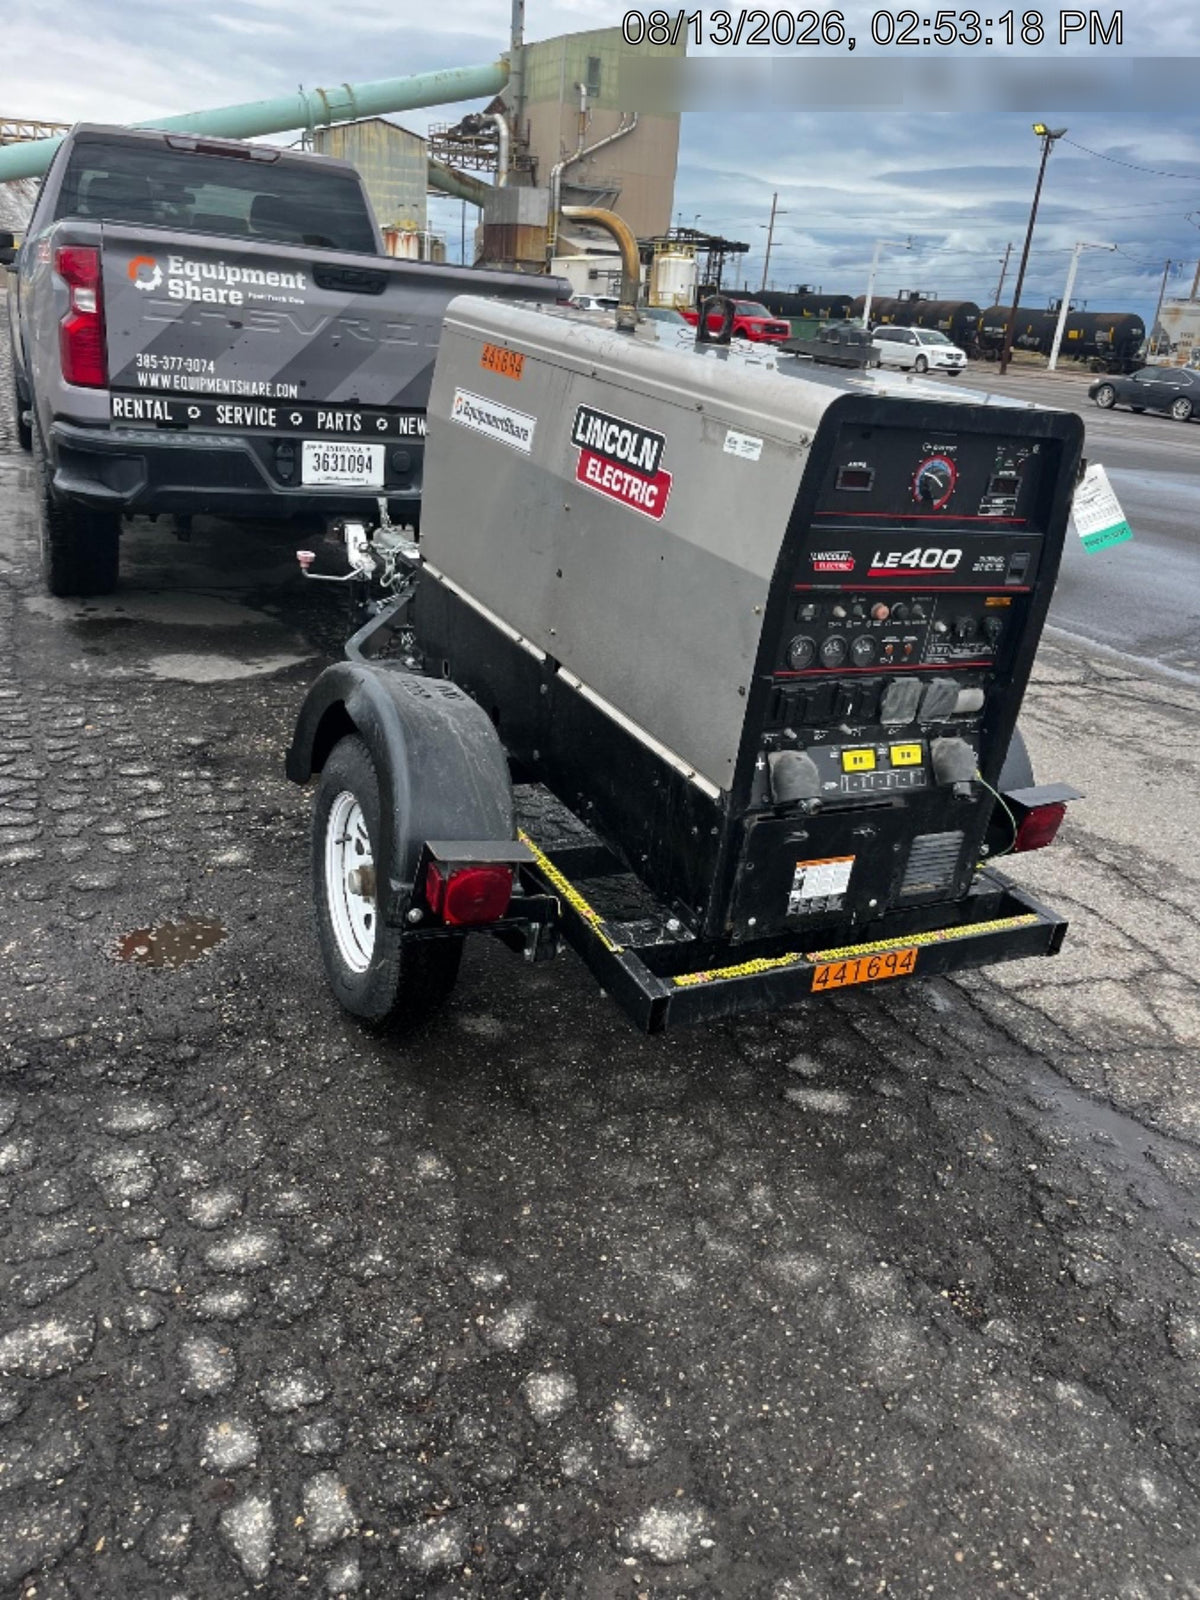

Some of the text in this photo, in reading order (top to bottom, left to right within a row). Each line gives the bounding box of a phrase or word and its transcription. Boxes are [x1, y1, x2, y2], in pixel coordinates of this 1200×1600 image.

[167, 256, 307, 291] Equipment
[168, 279, 244, 305] Share
[136, 353, 216, 374] 385-377-3074
[113, 398, 173, 421] RENTAL
[217, 405, 277, 427] SERVICE
[318, 411, 363, 432] PARTS
[575, 411, 660, 472] LINCOLN
[312, 452, 373, 474] 3631094
[586, 458, 659, 509] ELECTRIC
[870, 547, 963, 569] LE400
[815, 950, 914, 987] 441694
